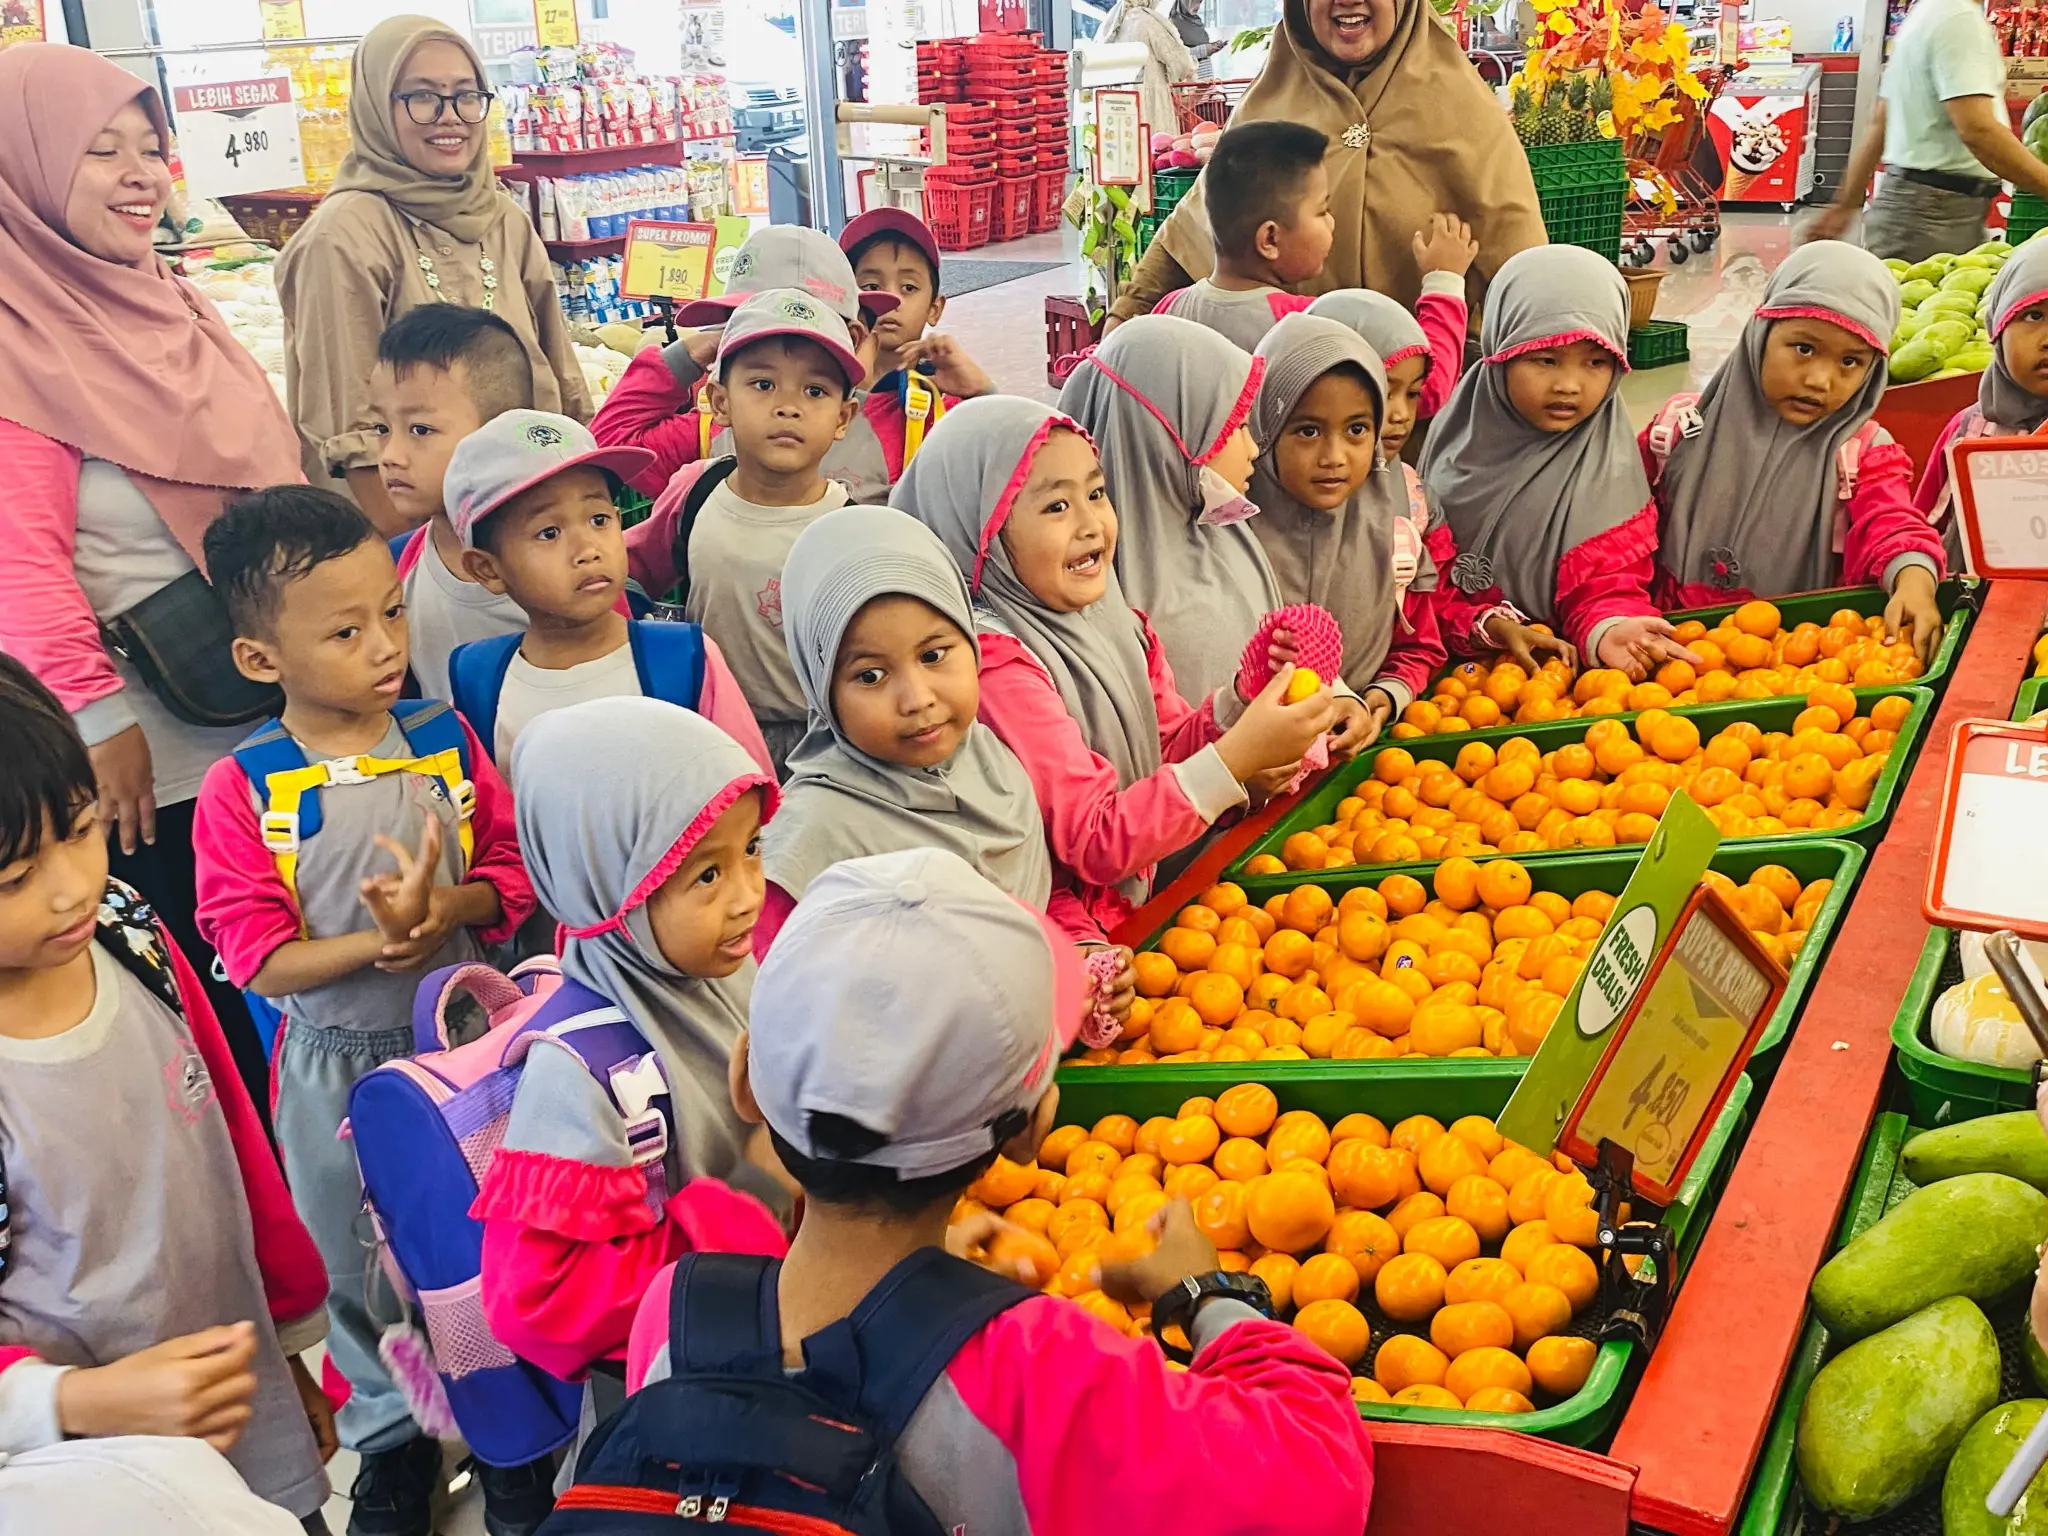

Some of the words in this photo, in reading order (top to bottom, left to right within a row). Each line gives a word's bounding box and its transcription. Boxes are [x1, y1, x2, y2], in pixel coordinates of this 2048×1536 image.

[188, 86, 233, 109] LEBIH
[235, 82, 279, 105] SEGAR
[225, 130, 269, 168] 4.980
[637, 227, 668, 241] SUPER
[1609, 923, 1645, 986] FRESH
[1675, 912, 1724, 979] SUPER
[1591, 954, 1627, 1013] DEALS!
